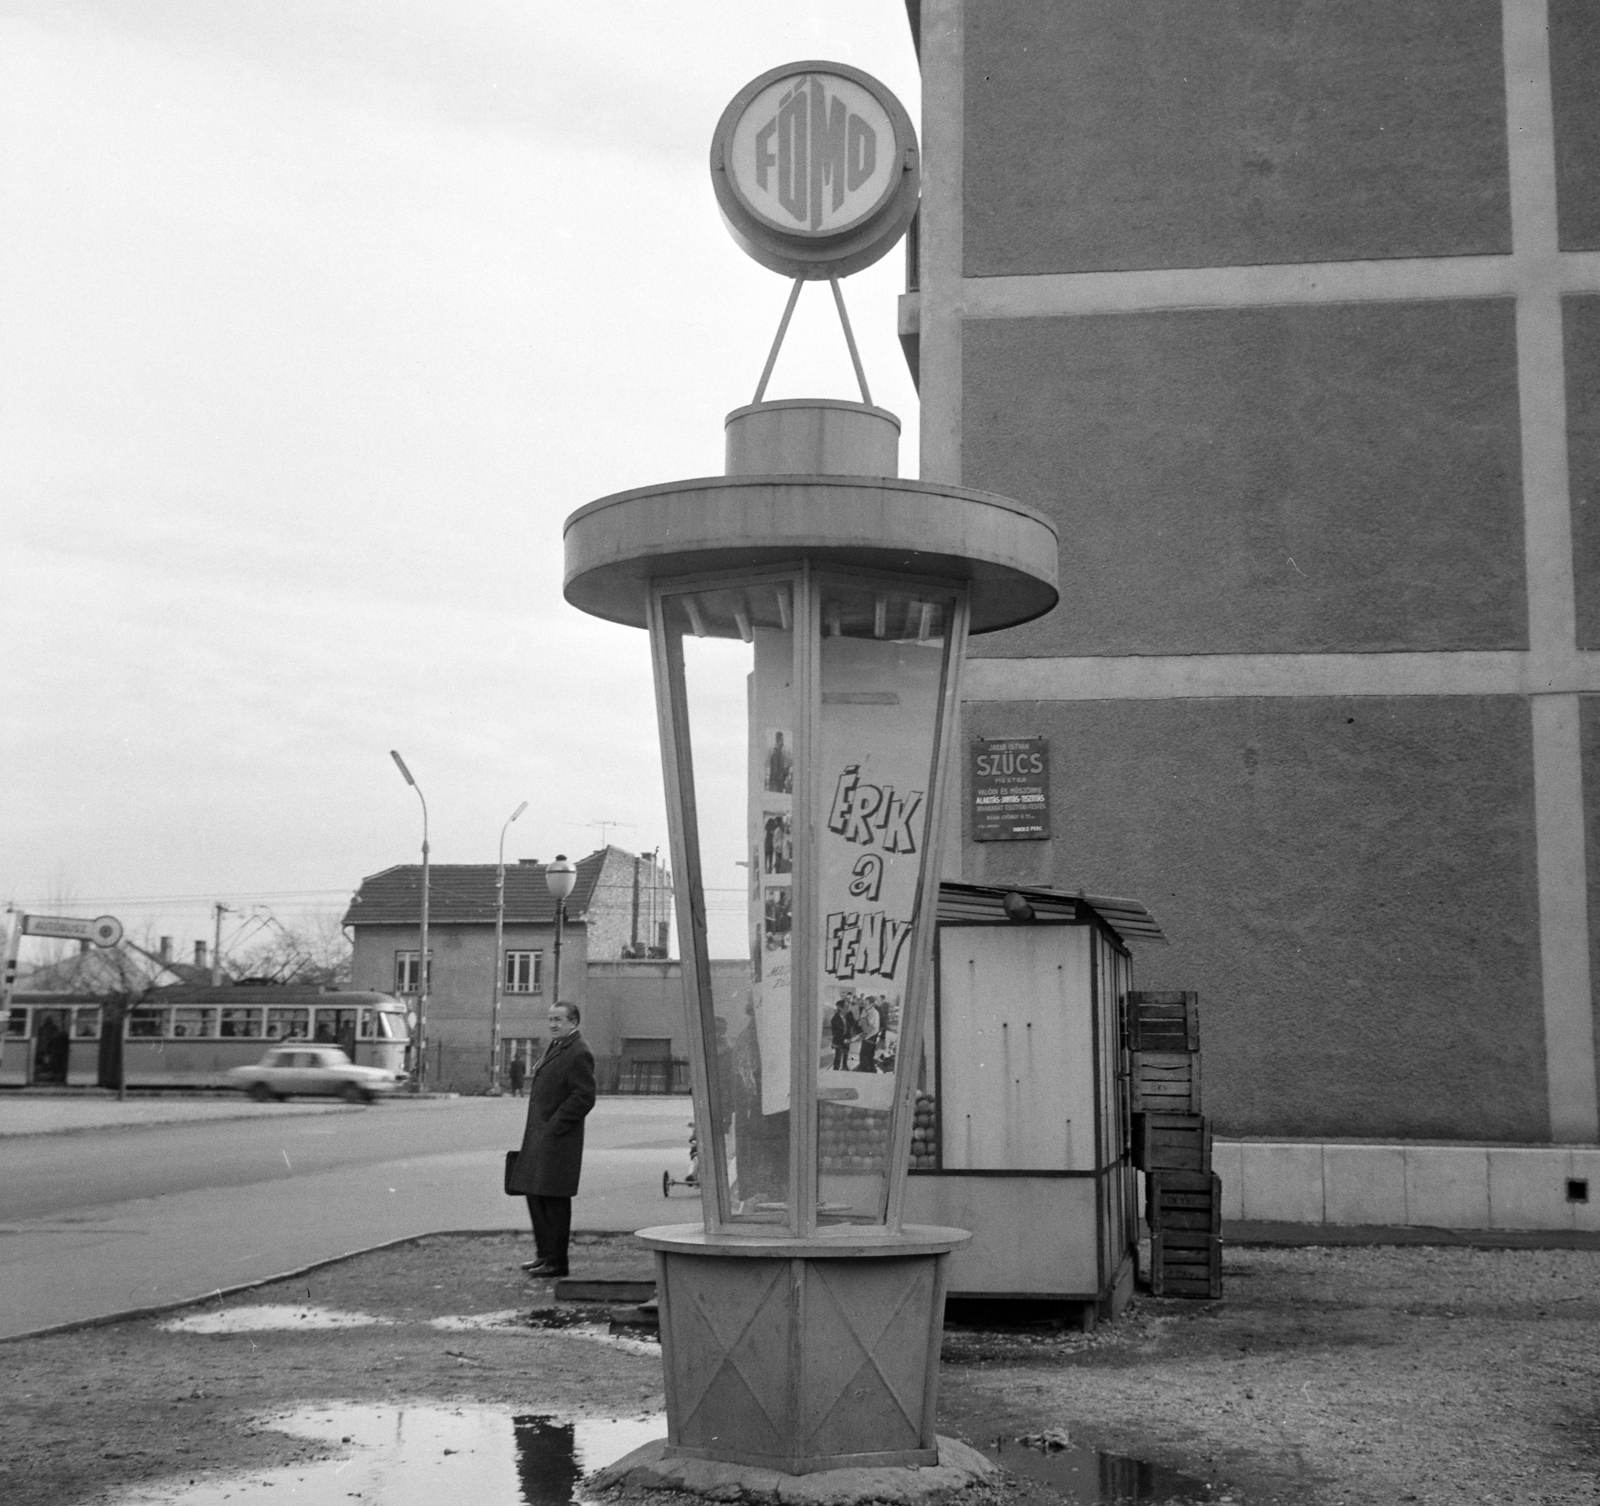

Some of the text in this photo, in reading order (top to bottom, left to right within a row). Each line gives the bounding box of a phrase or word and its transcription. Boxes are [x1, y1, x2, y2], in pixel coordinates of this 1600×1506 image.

[827, 764, 924, 854] ÉRIK
[1001, 787, 1008, 795] ÉS
[849, 853, 884, 901] a
[825, 910, 912, 980] FÉNY
